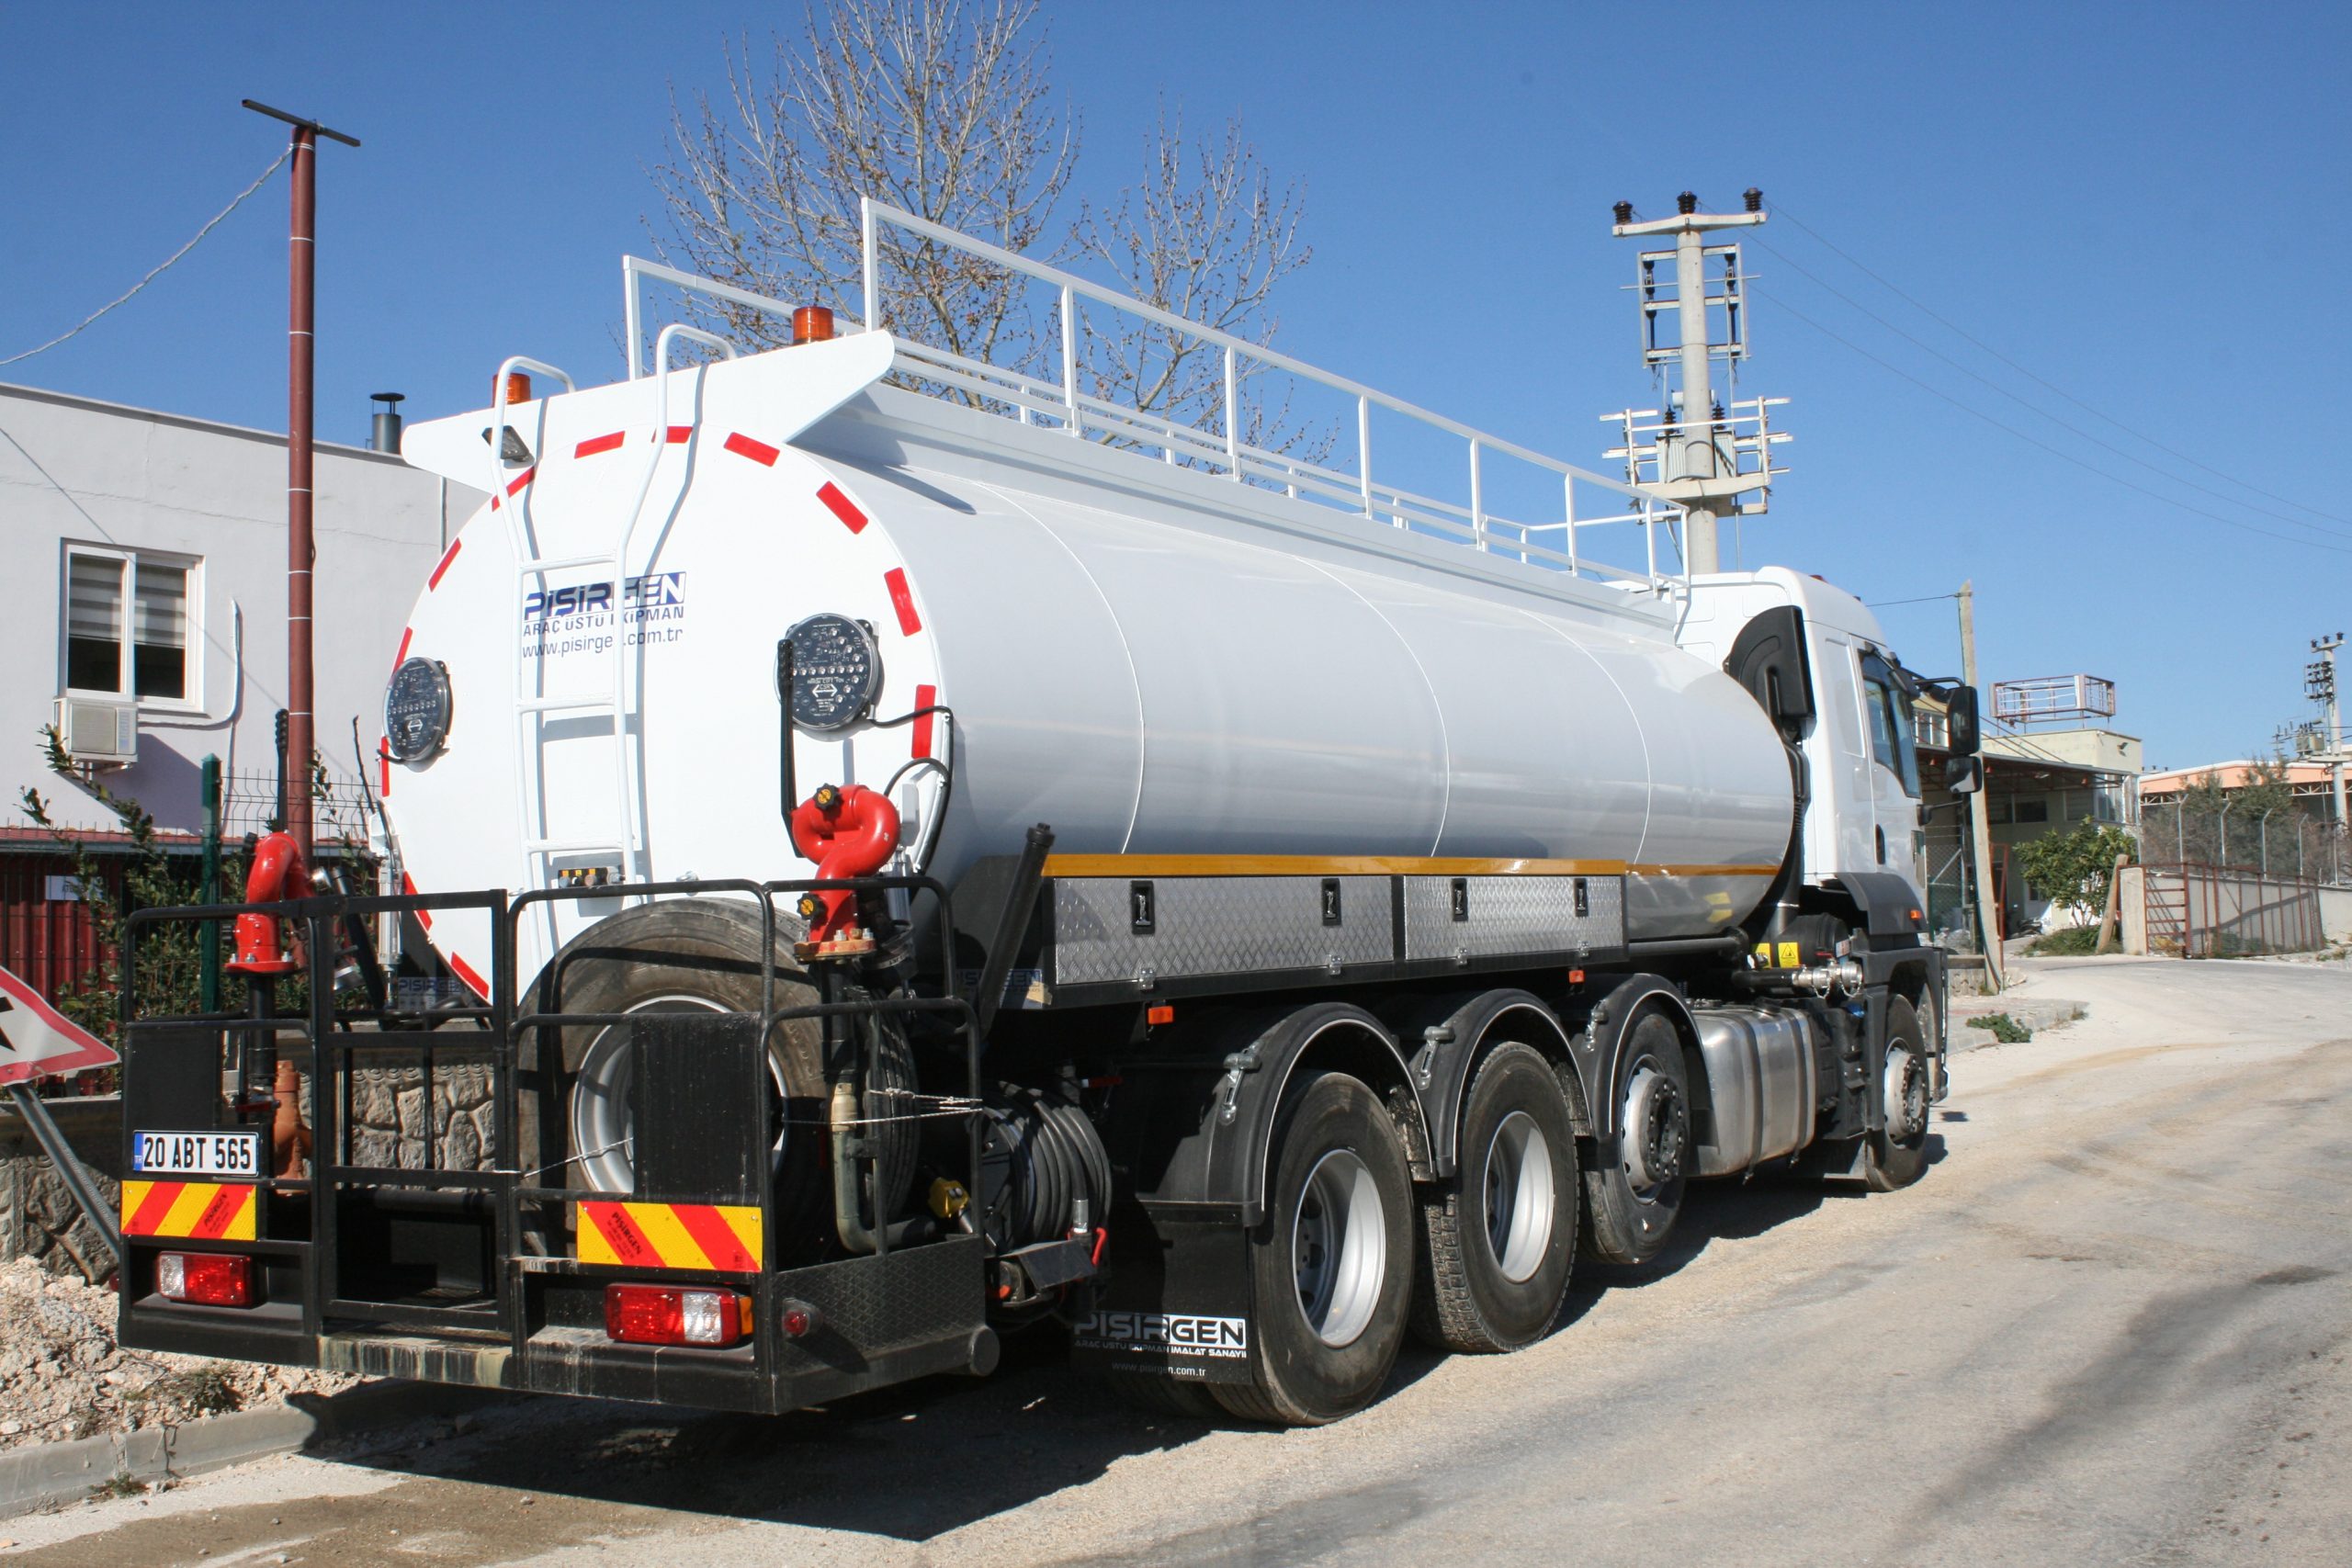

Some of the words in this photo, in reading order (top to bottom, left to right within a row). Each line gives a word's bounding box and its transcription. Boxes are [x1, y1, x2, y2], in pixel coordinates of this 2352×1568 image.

[523, 620, 560, 637] ARAÇ
[565, 615, 605, 630] ÜSTÜ
[522, 627, 684, 658] www.pisirge.com.tr
[143, 1136, 165, 1168] 20
[172, 1137, 207, 1168] ABT
[215, 1137, 251, 1169] 565
